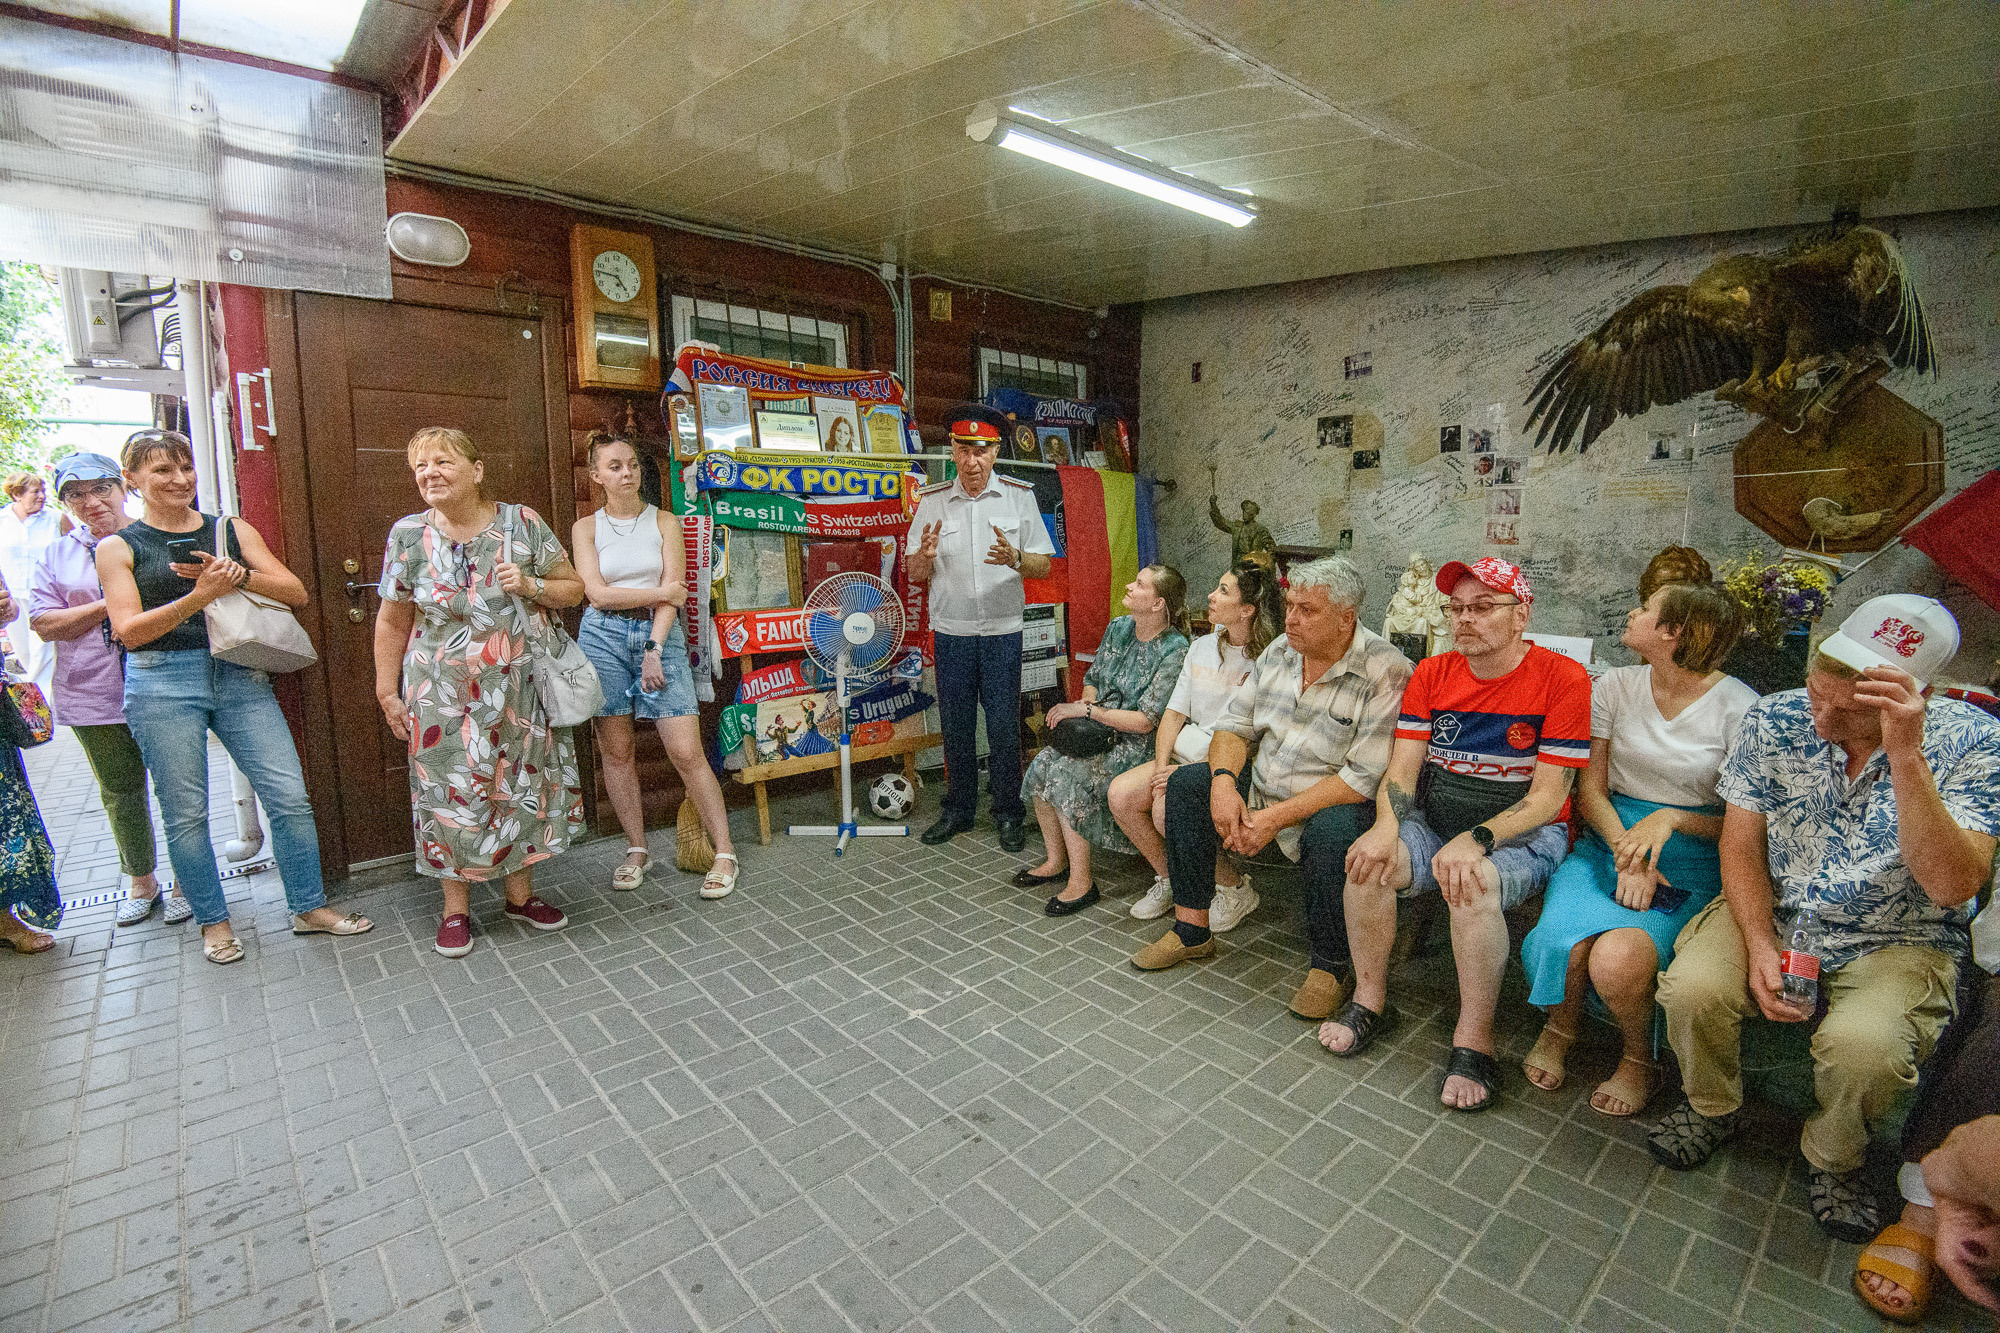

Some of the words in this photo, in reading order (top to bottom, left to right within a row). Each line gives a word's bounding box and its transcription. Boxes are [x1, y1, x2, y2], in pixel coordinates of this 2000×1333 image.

[692, 358, 796, 392] РОССИЯ
[741, 465, 796, 492] ФК
[715, 500, 784, 521] Brasil
[758, 521, 791, 533] ROSTOV
[791, 525, 821, 535] ARENA
[823, 528, 861, 536] 17.06.2018
[702, 532, 710, 568] ROSTOV
[905, 576, 923, 632] АТИЯ
[1430, 746, 1468, 761] РОЖДЕН
[1471, 754, 1479, 762] В
[879, 782, 906, 806] OFFICIAL
